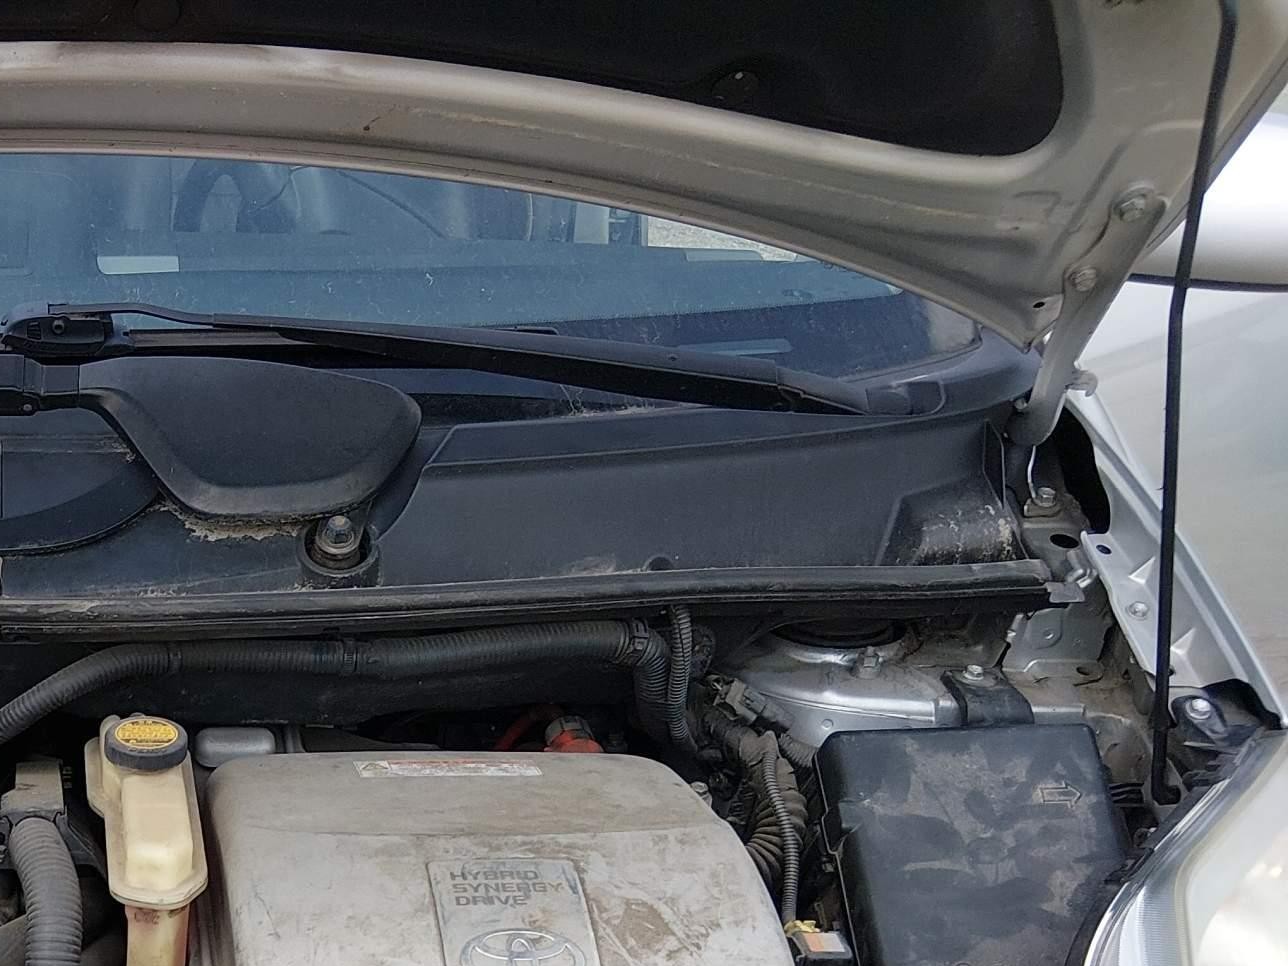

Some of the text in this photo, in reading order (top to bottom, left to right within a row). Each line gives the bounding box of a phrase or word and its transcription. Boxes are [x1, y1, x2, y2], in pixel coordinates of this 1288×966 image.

[449, 870, 540, 881] HYBRID
[452, 882, 563, 894] SYNERGY
[455, 895, 529, 907] DRIVE
